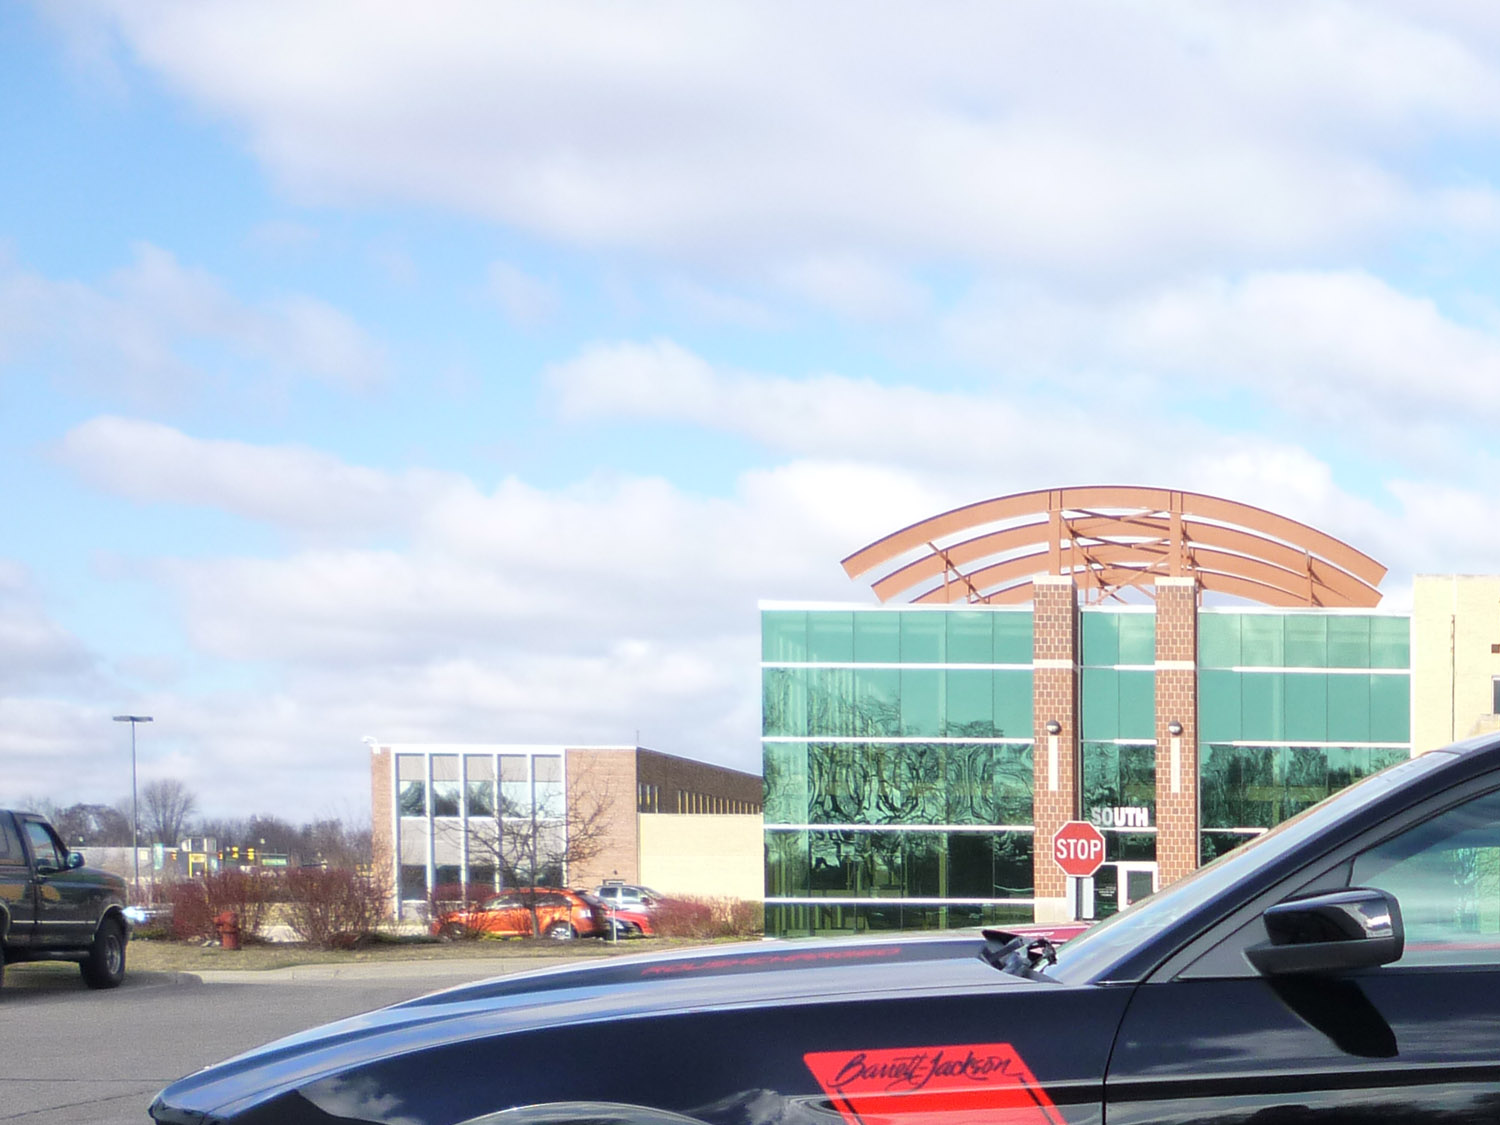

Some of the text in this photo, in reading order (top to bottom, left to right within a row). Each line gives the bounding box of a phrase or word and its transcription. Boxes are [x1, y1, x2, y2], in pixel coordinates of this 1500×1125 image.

[1091, 807, 1149, 827] SOUTH
[1056, 838, 1101, 860] STOP
[827, 1050, 1023, 1096] Barrett-Jackson
